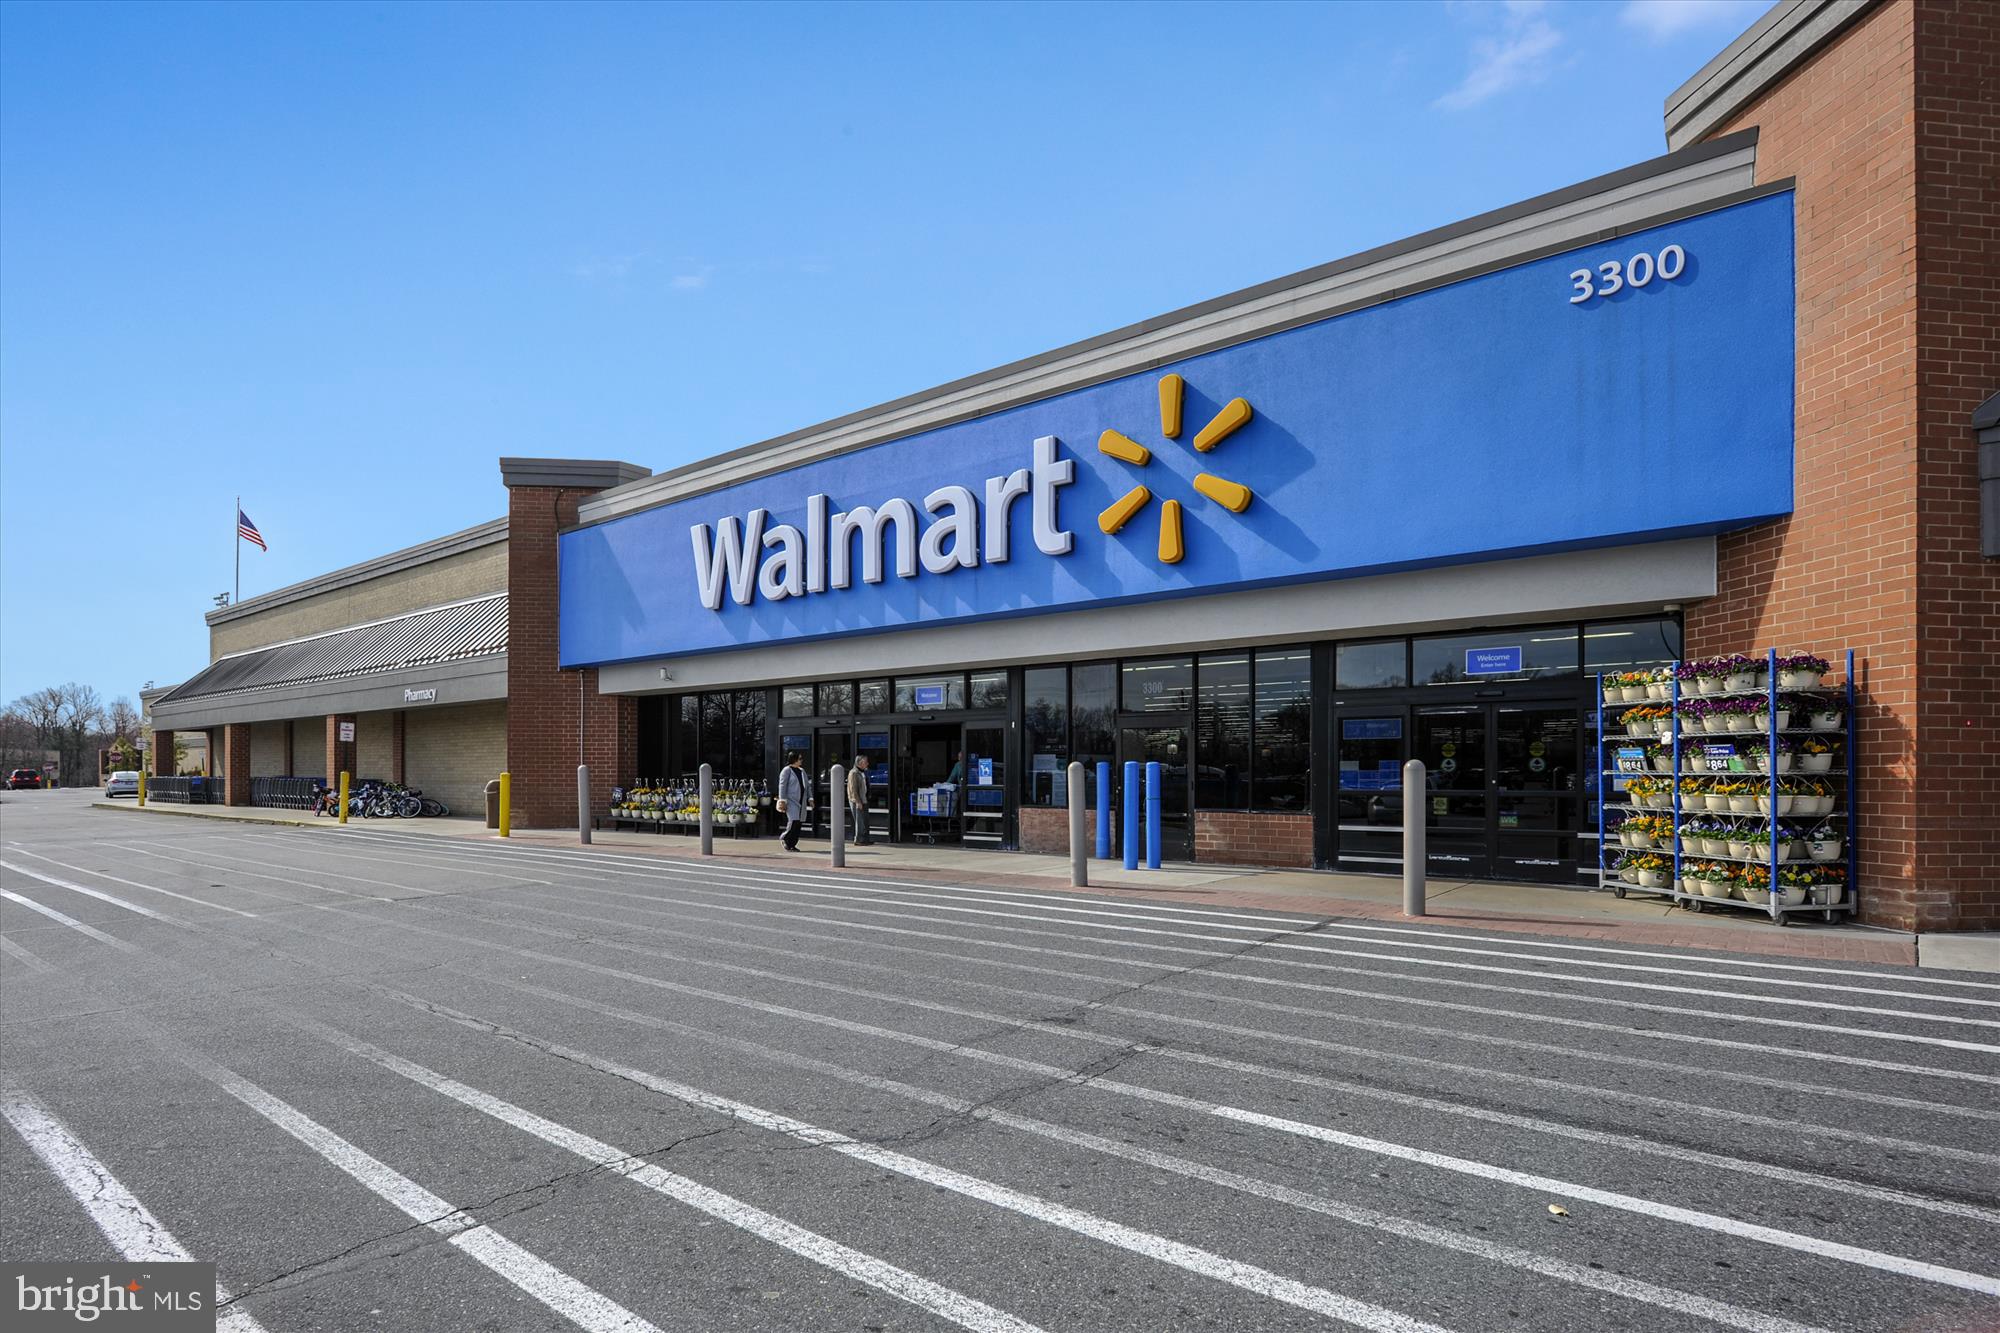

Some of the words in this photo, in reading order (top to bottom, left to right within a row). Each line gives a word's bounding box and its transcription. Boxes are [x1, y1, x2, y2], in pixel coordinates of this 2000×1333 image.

[1569, 244, 1686, 304] 3300
[690, 435, 1074, 611] Walmart
[1476, 653, 1511, 662] Welcome
[404, 688, 437, 703] Pharmacy
[1142, 681, 1163, 695] 3300
